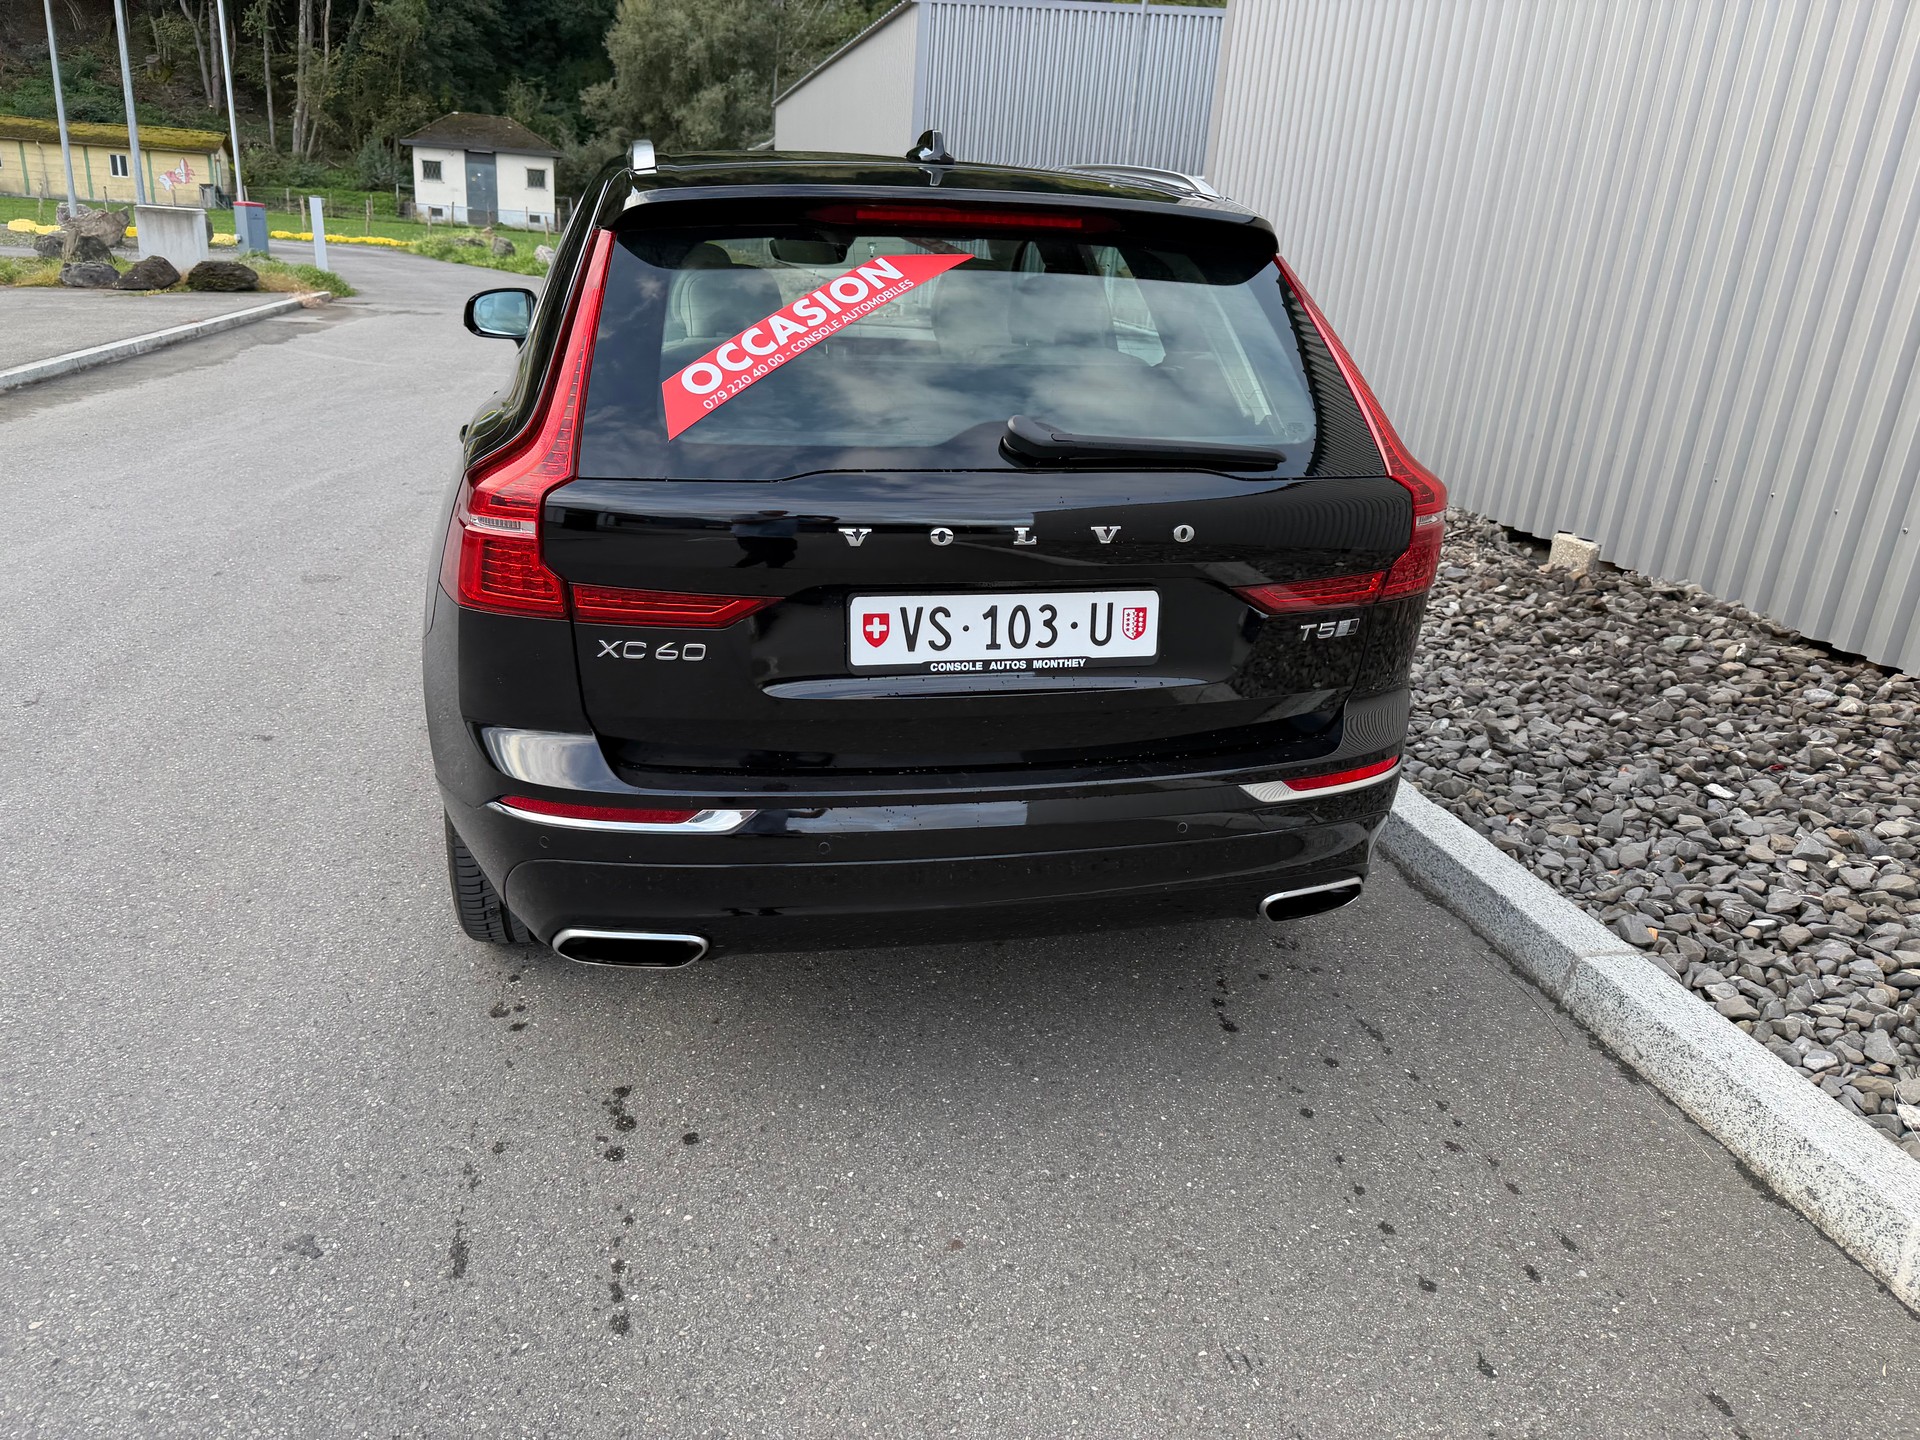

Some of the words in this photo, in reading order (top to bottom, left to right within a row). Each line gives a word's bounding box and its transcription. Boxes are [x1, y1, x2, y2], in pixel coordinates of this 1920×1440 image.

[681, 257, 904, 394] OCCASION
[703, 390, 728, 410] 079
[726, 374, 752, 393] 220
[752, 364, 768, 378] 40
[767, 353, 785, 367] 00
[790, 319, 843, 353] CONSOLE
[841, 278, 915, 324] AUTOMOBILES
[838, 524, 1195, 547] VOLVO
[1300, 621, 1337, 641] T5
[929, 661, 983, 672] CONSOLE
[989, 660, 1027, 670] AUTOS
[1032, 658, 1086, 669] MONTHEY
